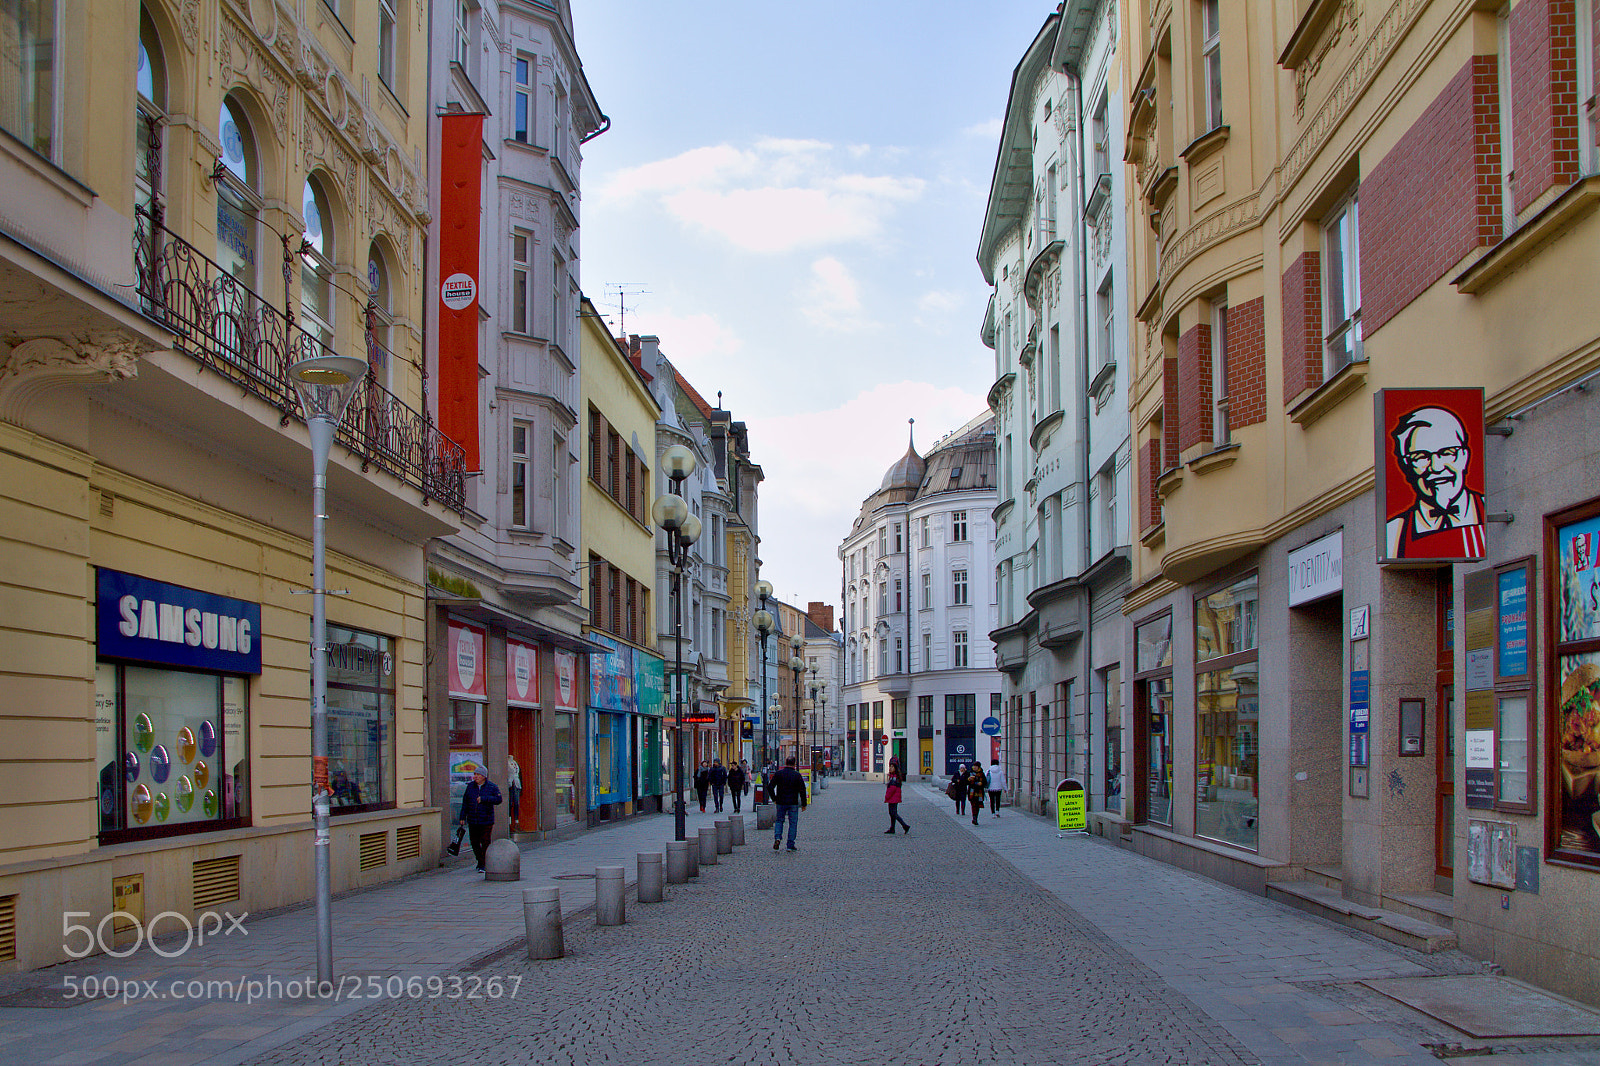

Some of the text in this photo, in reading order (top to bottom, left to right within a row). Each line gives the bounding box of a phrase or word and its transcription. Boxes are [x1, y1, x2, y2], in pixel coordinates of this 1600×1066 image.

[445, 280, 472, 290] TEXTILE
[1299, 550, 1331, 589] IDENTITY
[118, 593, 252, 654] SAMSUNG
[327, 641, 376, 673] KNIHY
